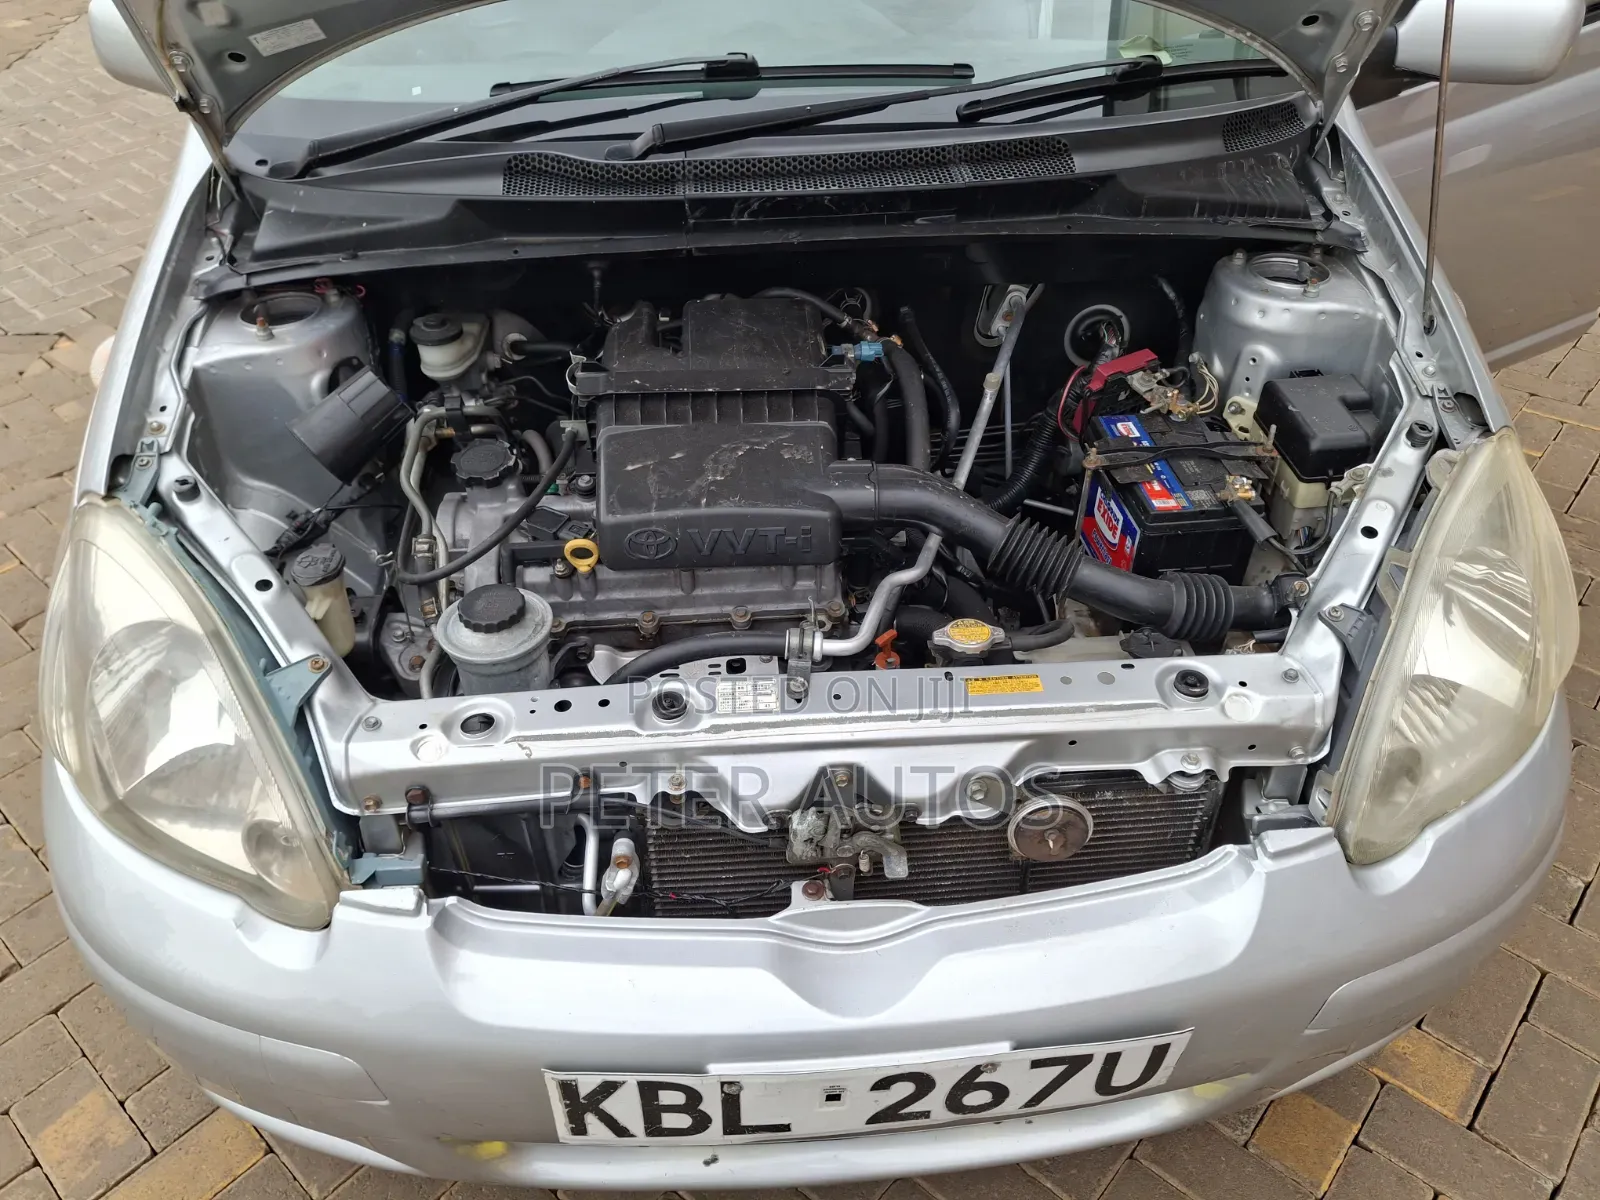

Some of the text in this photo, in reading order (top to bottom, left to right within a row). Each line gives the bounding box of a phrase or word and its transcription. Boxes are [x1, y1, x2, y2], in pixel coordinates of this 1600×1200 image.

[1096, 498, 1119, 540] EXIDE
[687, 526, 812, 556] VVT-i
[553, 1042, 1172, 1138] KBL 267U
